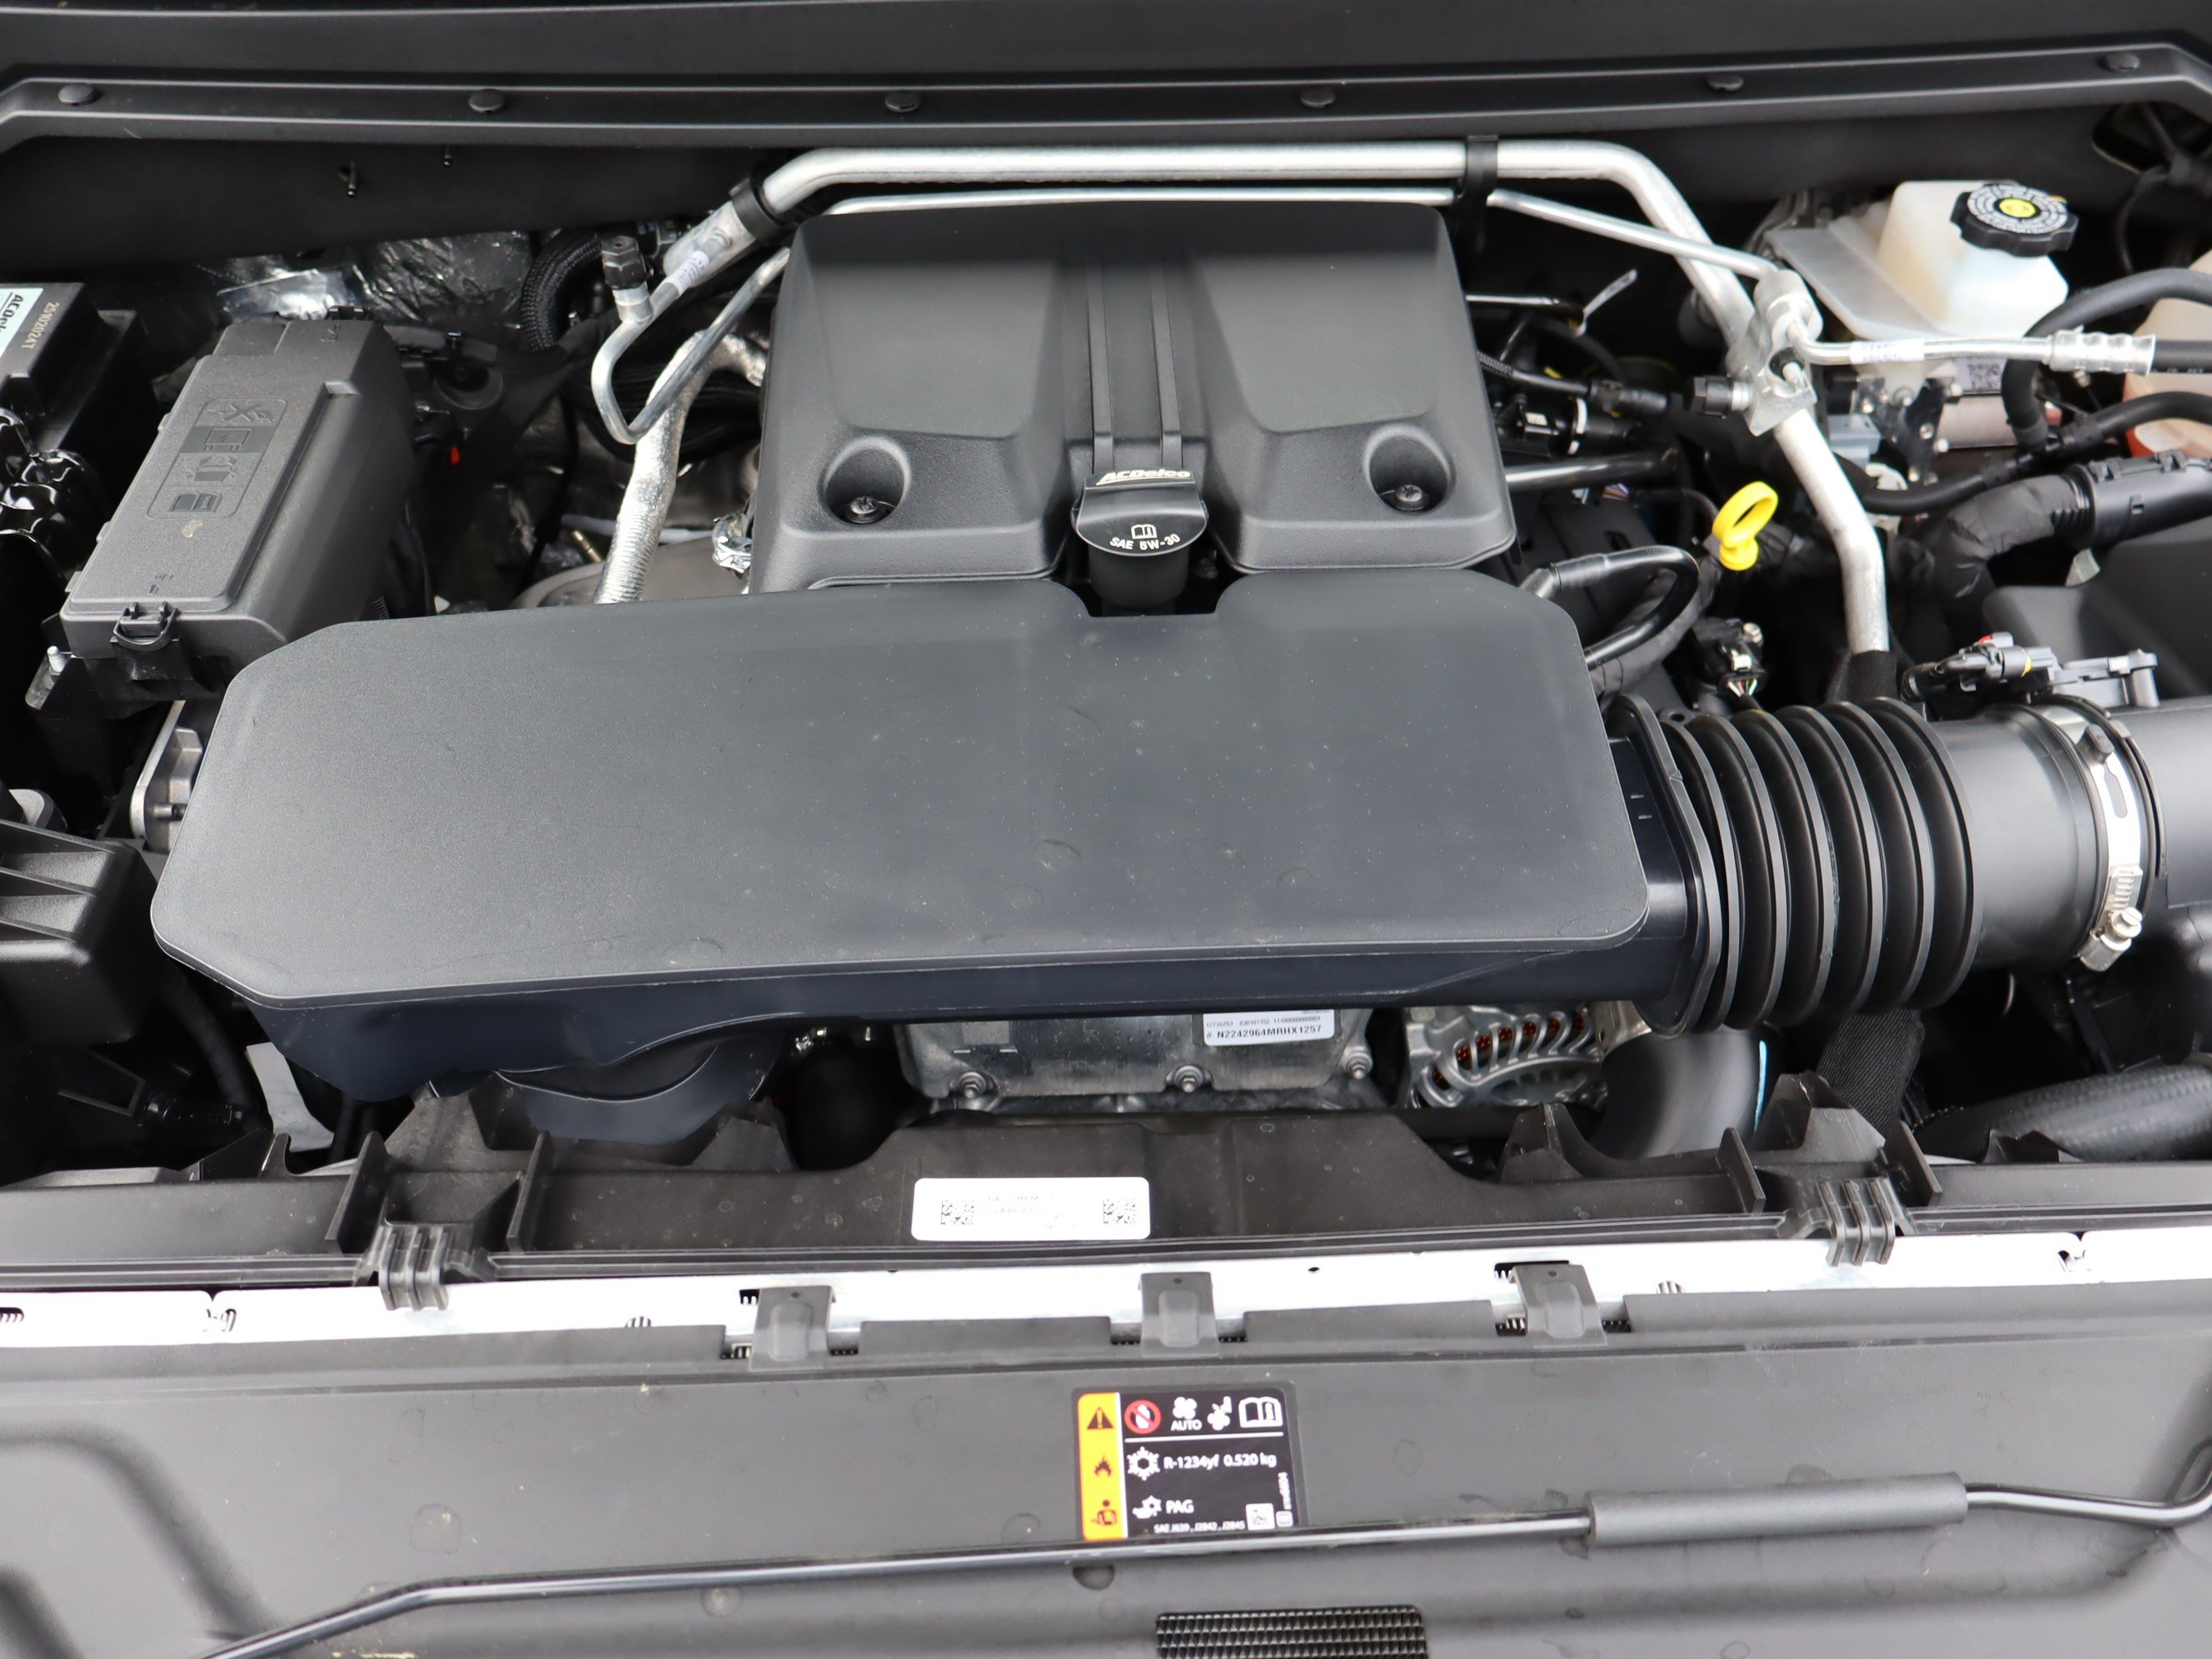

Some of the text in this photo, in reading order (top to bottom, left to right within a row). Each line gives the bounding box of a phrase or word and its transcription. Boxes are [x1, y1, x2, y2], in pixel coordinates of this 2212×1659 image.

[21, 301, 60, 350] 25102024T
[1097, 469, 1191, 485] ACDelco
[1110, 533, 1181, 551] SAE 5W-30
[1171, 1419, 1202, 1432] AUTO
[1163, 1452, 1277, 1471] R-1234yf 0.520 kg
[1166, 1499, 1194, 1514] PAG
[1153, 1523, 1170, 1534] SAE
